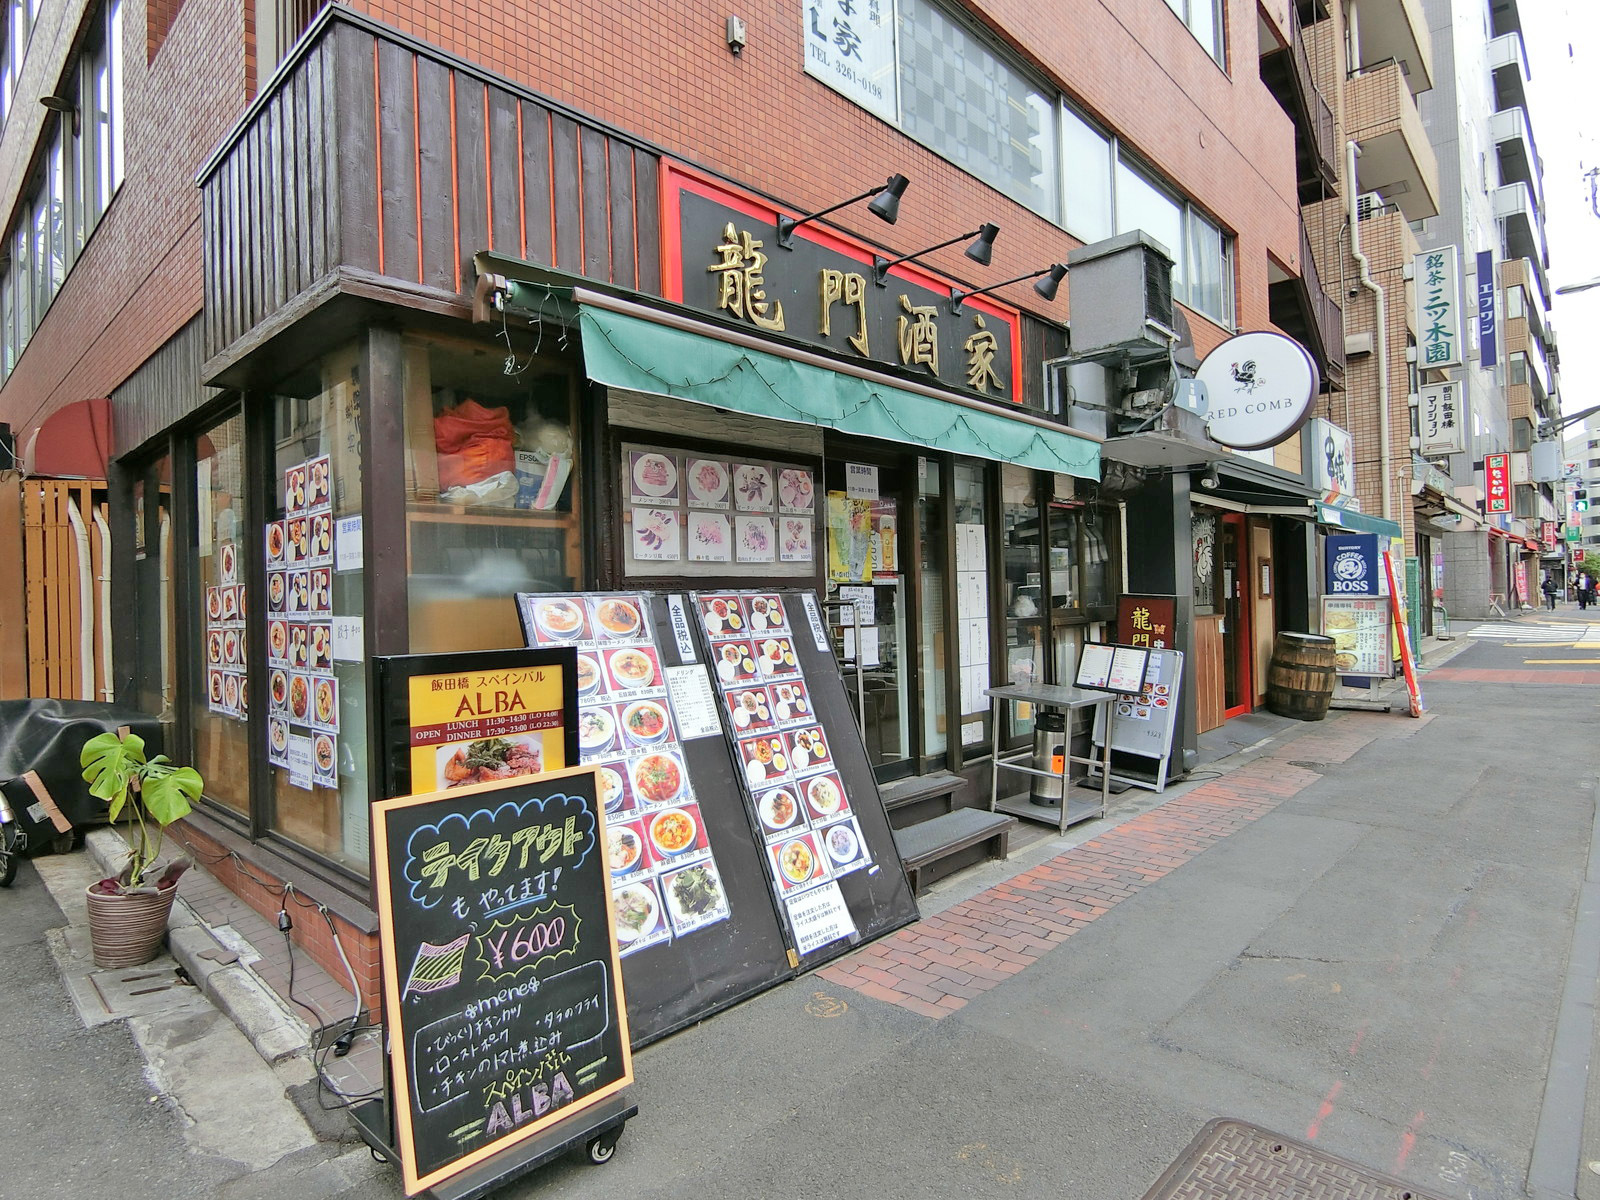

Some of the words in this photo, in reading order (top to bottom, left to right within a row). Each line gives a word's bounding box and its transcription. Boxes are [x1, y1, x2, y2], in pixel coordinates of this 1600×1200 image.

[809, 42, 830, 67] TEL
[835, 59, 882, 100] 3261-0198
[707, 222, 1005, 393] 龍門酒家
[1479, 282, 1494, 336] エフワン
[1207, 407, 1238, 421] RED
[1245, 398, 1293, 415] COMB
[1427, 395, 1438, 438] マンション
[1336, 551, 1364, 562] COFFEE
[1332, 580, 1369, 592] BOSS
[671, 604, 692, 654] 全品税込
[806, 601, 826, 644] 全品税込
[431, 676, 470, 692] 飯田橋
[476, 670, 546, 688] スペインバル
[454, 688, 527, 718] ALBA
[415, 729, 441, 740] OPEN
[446, 729, 482, 742] DINNER
[447, 719, 479, 731] LUNCH
[421, 815, 584, 889] テイクアウト
[485, 1071, 575, 1138] ALBA
